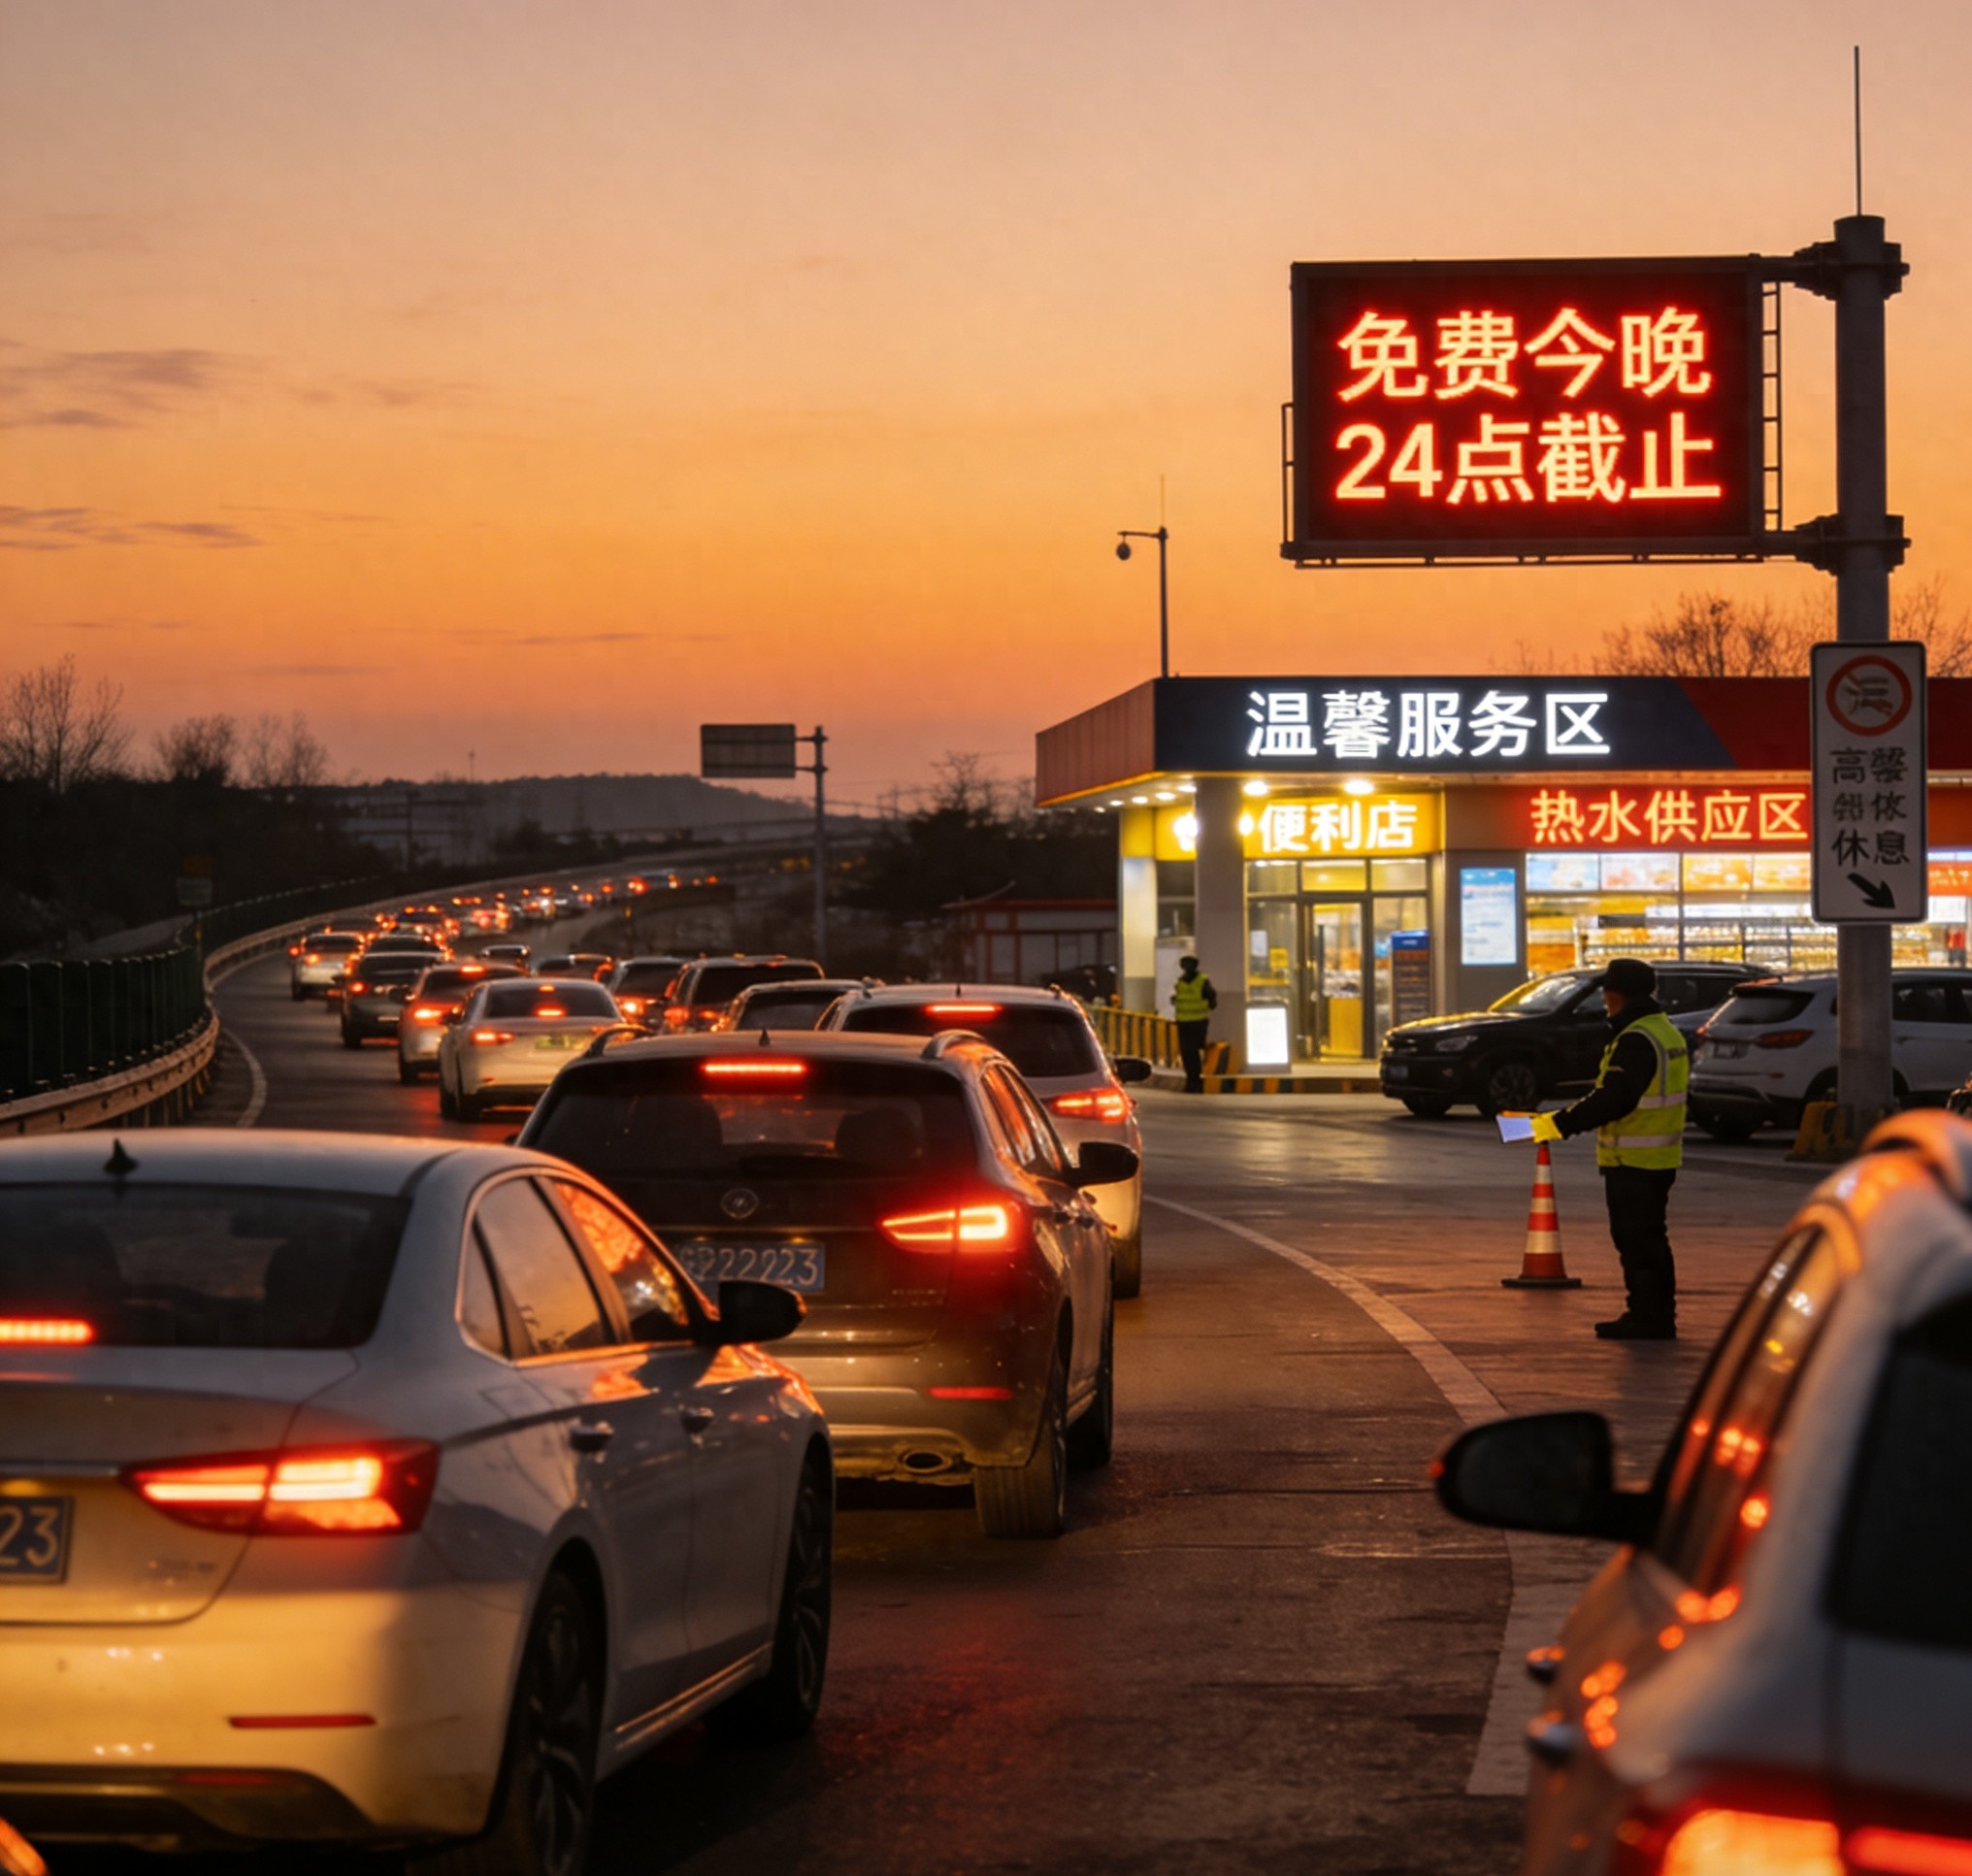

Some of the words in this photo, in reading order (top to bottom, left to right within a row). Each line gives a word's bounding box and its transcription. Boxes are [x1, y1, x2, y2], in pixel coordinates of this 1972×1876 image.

[1337, 307, 1712, 402] 免费今晚
[1335, 411, 1721, 504] 24点截止
[1246, 689, 1611, 759] 温馨服务区
[1258, 800, 1418, 853] 便利店
[1530, 789, 1808, 844] 热水供应区
[1831, 828, 1910, 868] 休息
[0, 1505, 59, 1567] 23
